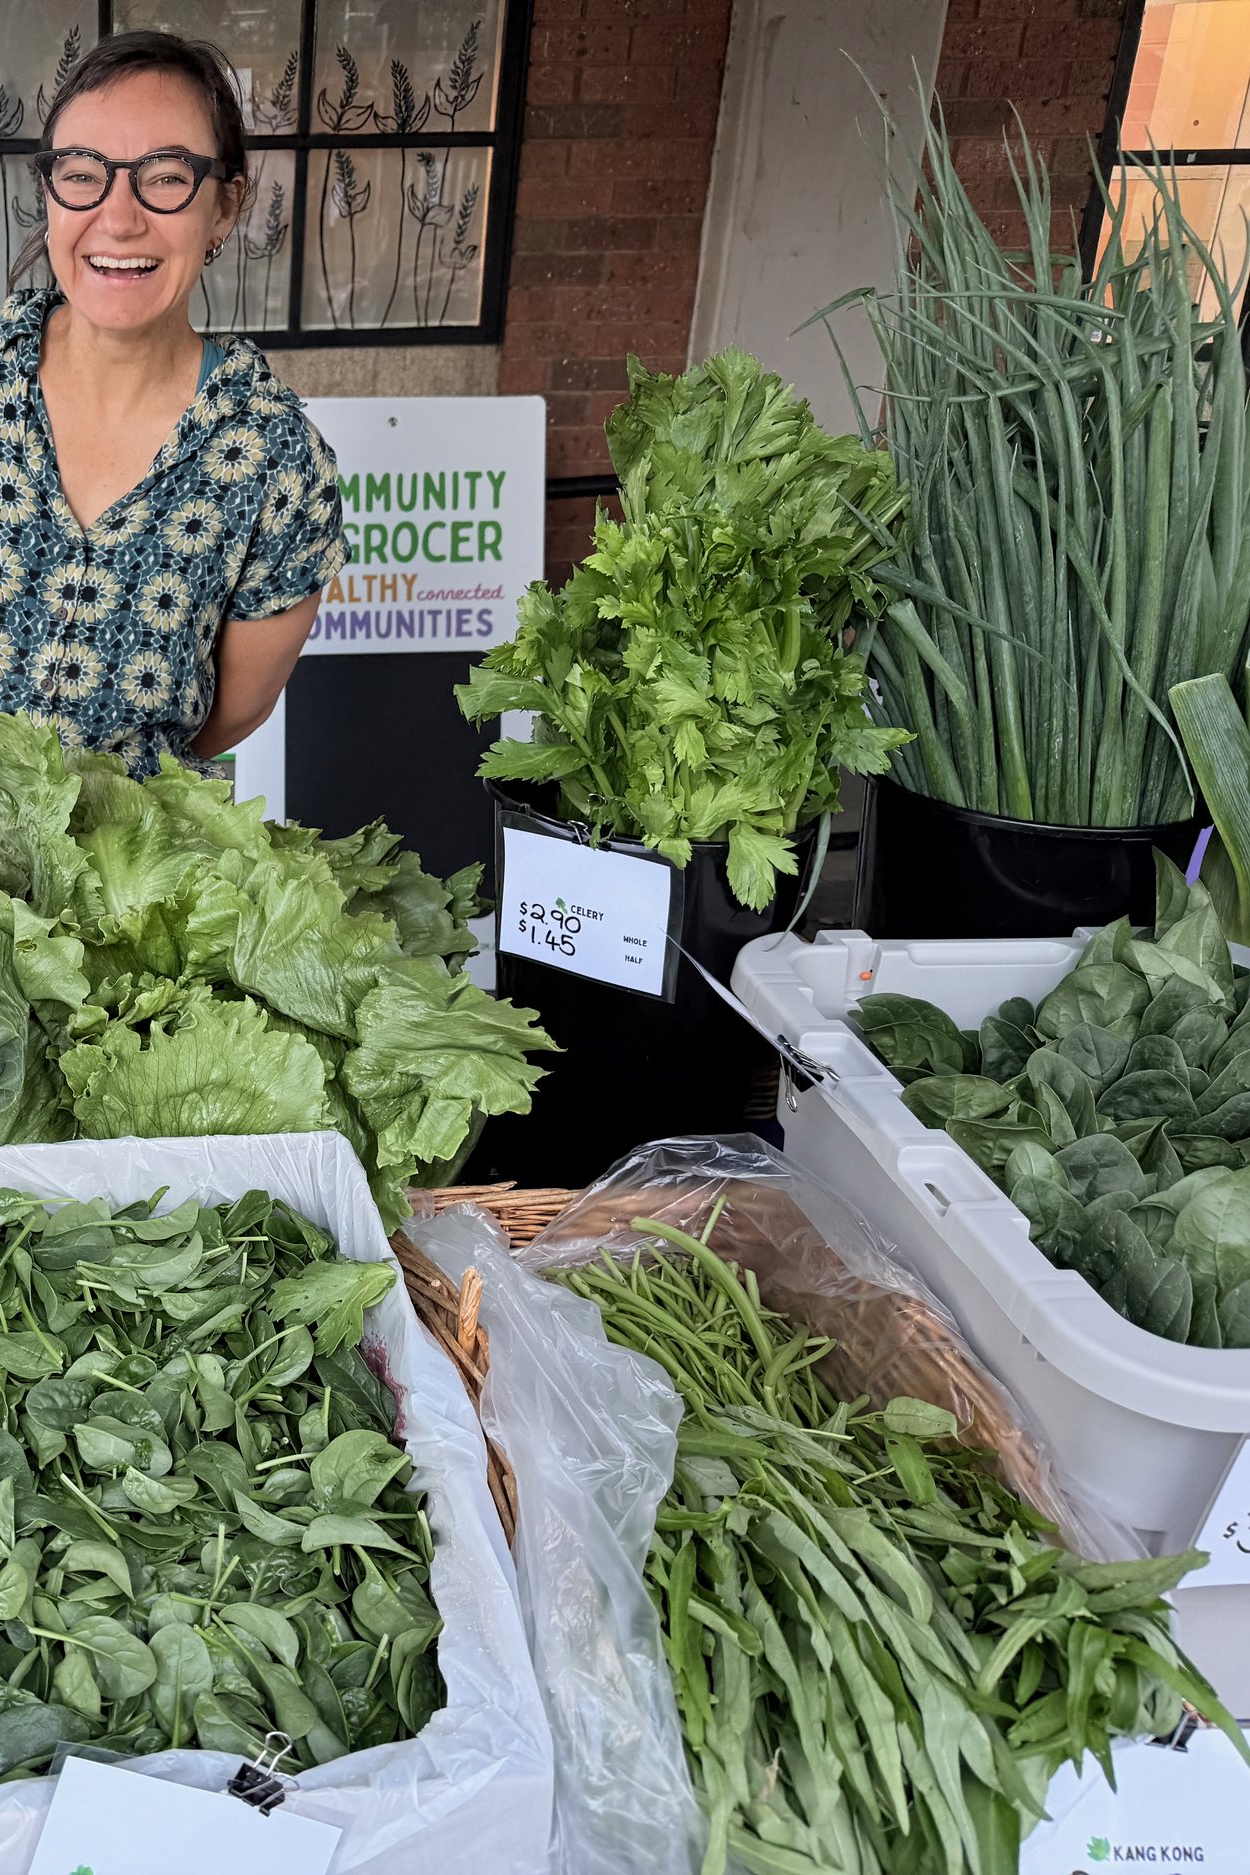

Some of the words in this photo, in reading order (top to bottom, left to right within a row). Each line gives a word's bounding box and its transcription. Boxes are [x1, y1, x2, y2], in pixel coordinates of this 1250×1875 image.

[337, 471, 506, 513] MMUNITY
[321, 573, 418, 604] ALTHY
[416, 583, 504, 600] connected
[307, 608, 494, 640] OMMUNITIES
[519, 901, 581, 934] $2.90
[623, 935, 647, 948] WHOLE
[570, 905, 604, 921] CELERY
[518, 919, 576, 957] $1.45
[624, 954, 643, 965] HALF
[1113, 1846, 1156, 1862] KANG
[1161, 1846, 1204, 1863] KONG
